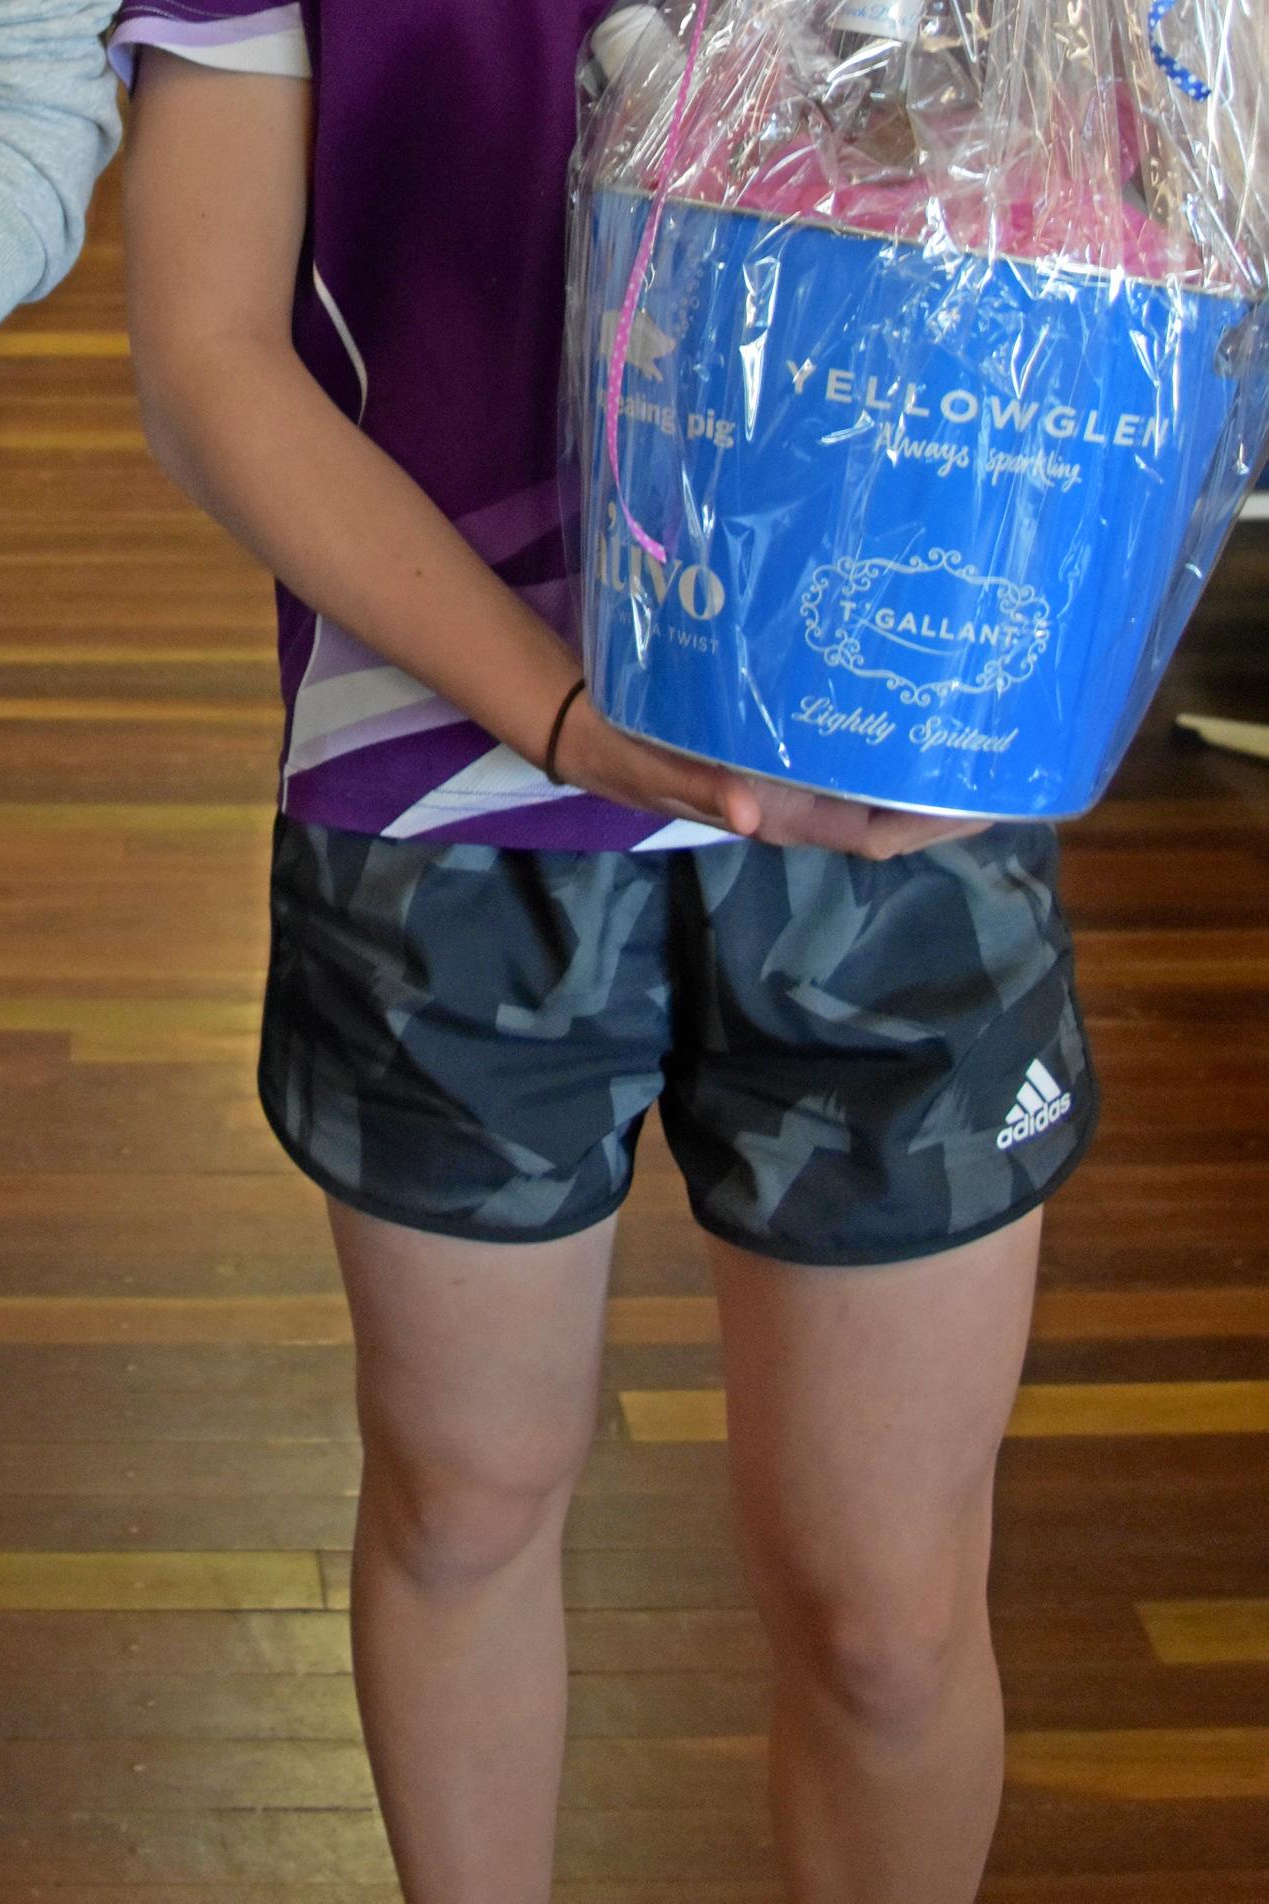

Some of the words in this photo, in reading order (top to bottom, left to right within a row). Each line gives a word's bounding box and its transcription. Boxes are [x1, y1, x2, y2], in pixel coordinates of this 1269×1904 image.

[687, 408, 736, 448] pig
[787, 359, 1169, 451] YELLOWGLEN
[986, 442, 1082, 493] sparkling
[668, 626, 720, 655] TWIST
[791, 696, 897, 746] Lightly
[995, 1091, 1072, 1150] adidas
